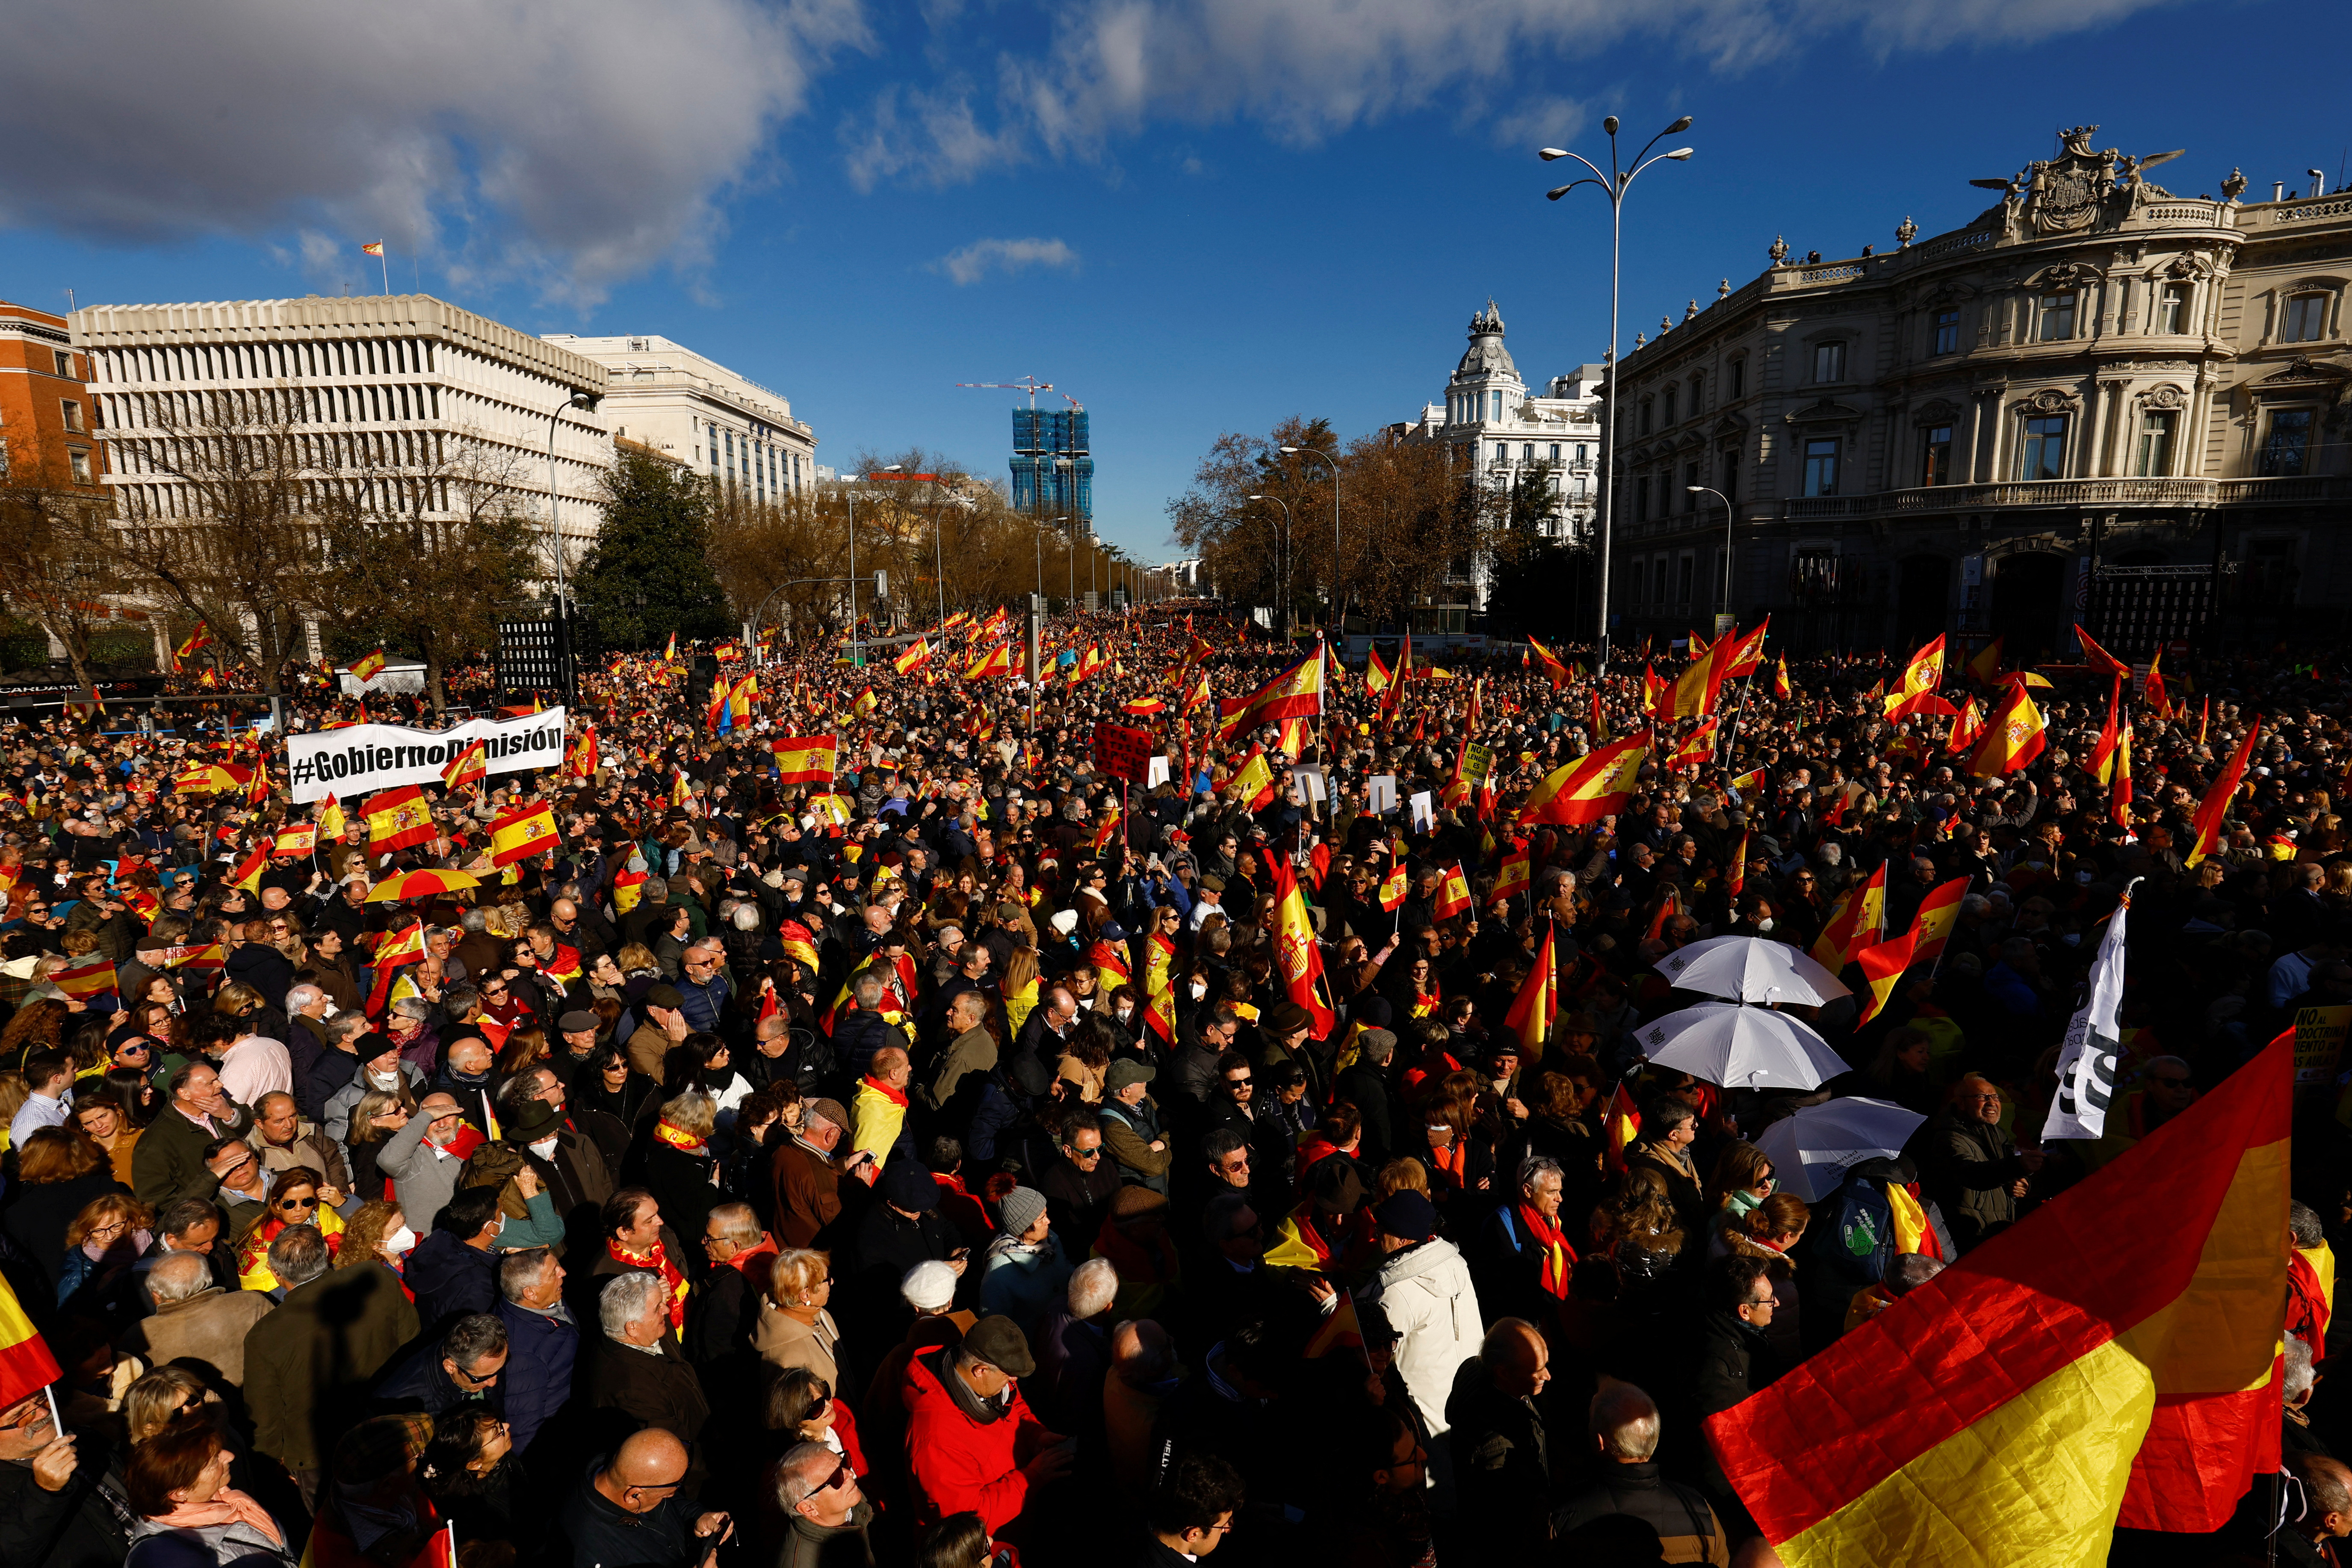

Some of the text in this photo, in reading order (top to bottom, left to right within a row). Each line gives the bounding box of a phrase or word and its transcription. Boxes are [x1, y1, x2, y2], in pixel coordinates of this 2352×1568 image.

[1471, 744, 1482, 754] NO
[1467, 753, 1489, 765] LENGUA
[1462, 767, 1486, 780] SEPARATISMO
[2296, 1008, 2326, 1026] NO AL
[2295, 1039, 2338, 1053] IENTO EN
[2305, 1054, 2336, 1067] AULAS
[1823, 1150, 1858, 1170] Libertad
[1827, 1154, 1864, 1175] Elección
[1859, 1208, 1876, 1228] SPORT
[1854, 1215, 1879, 1245] FASHION
